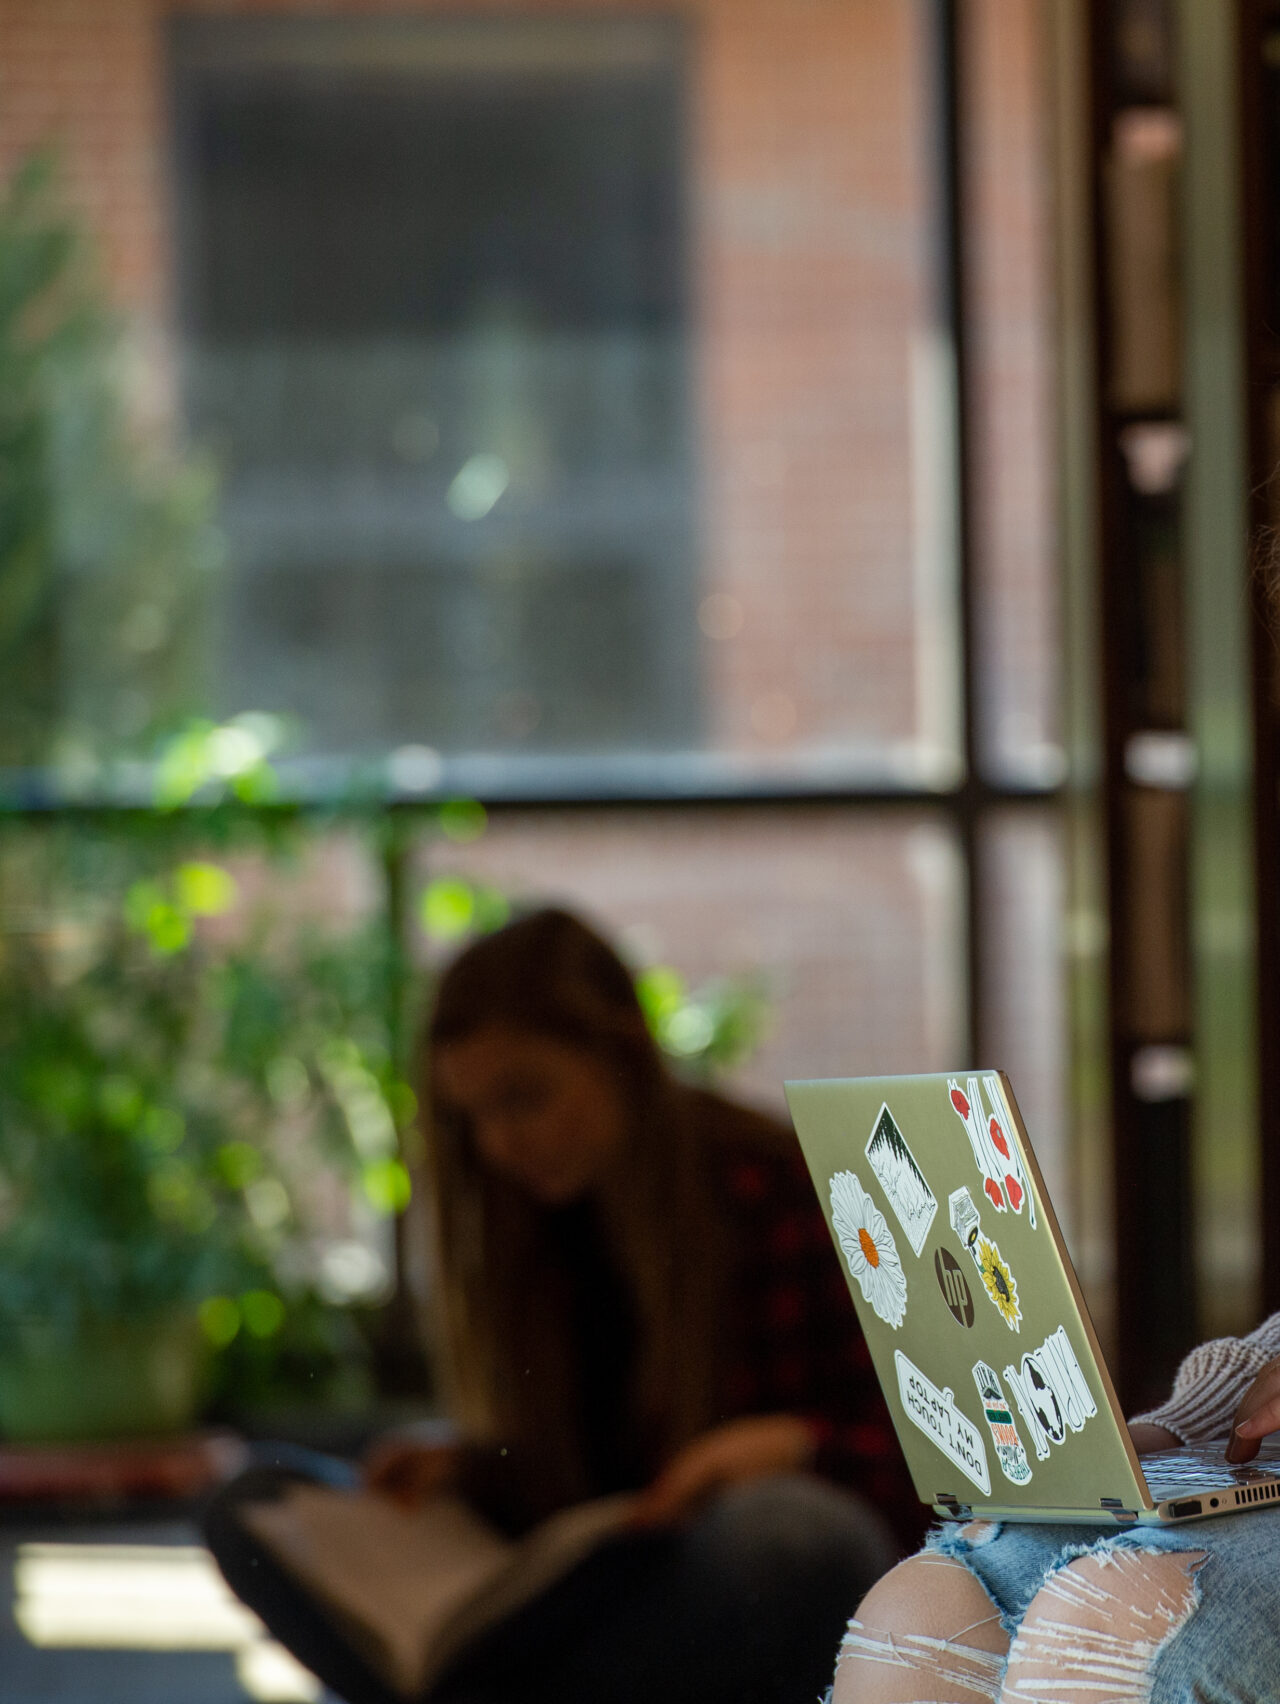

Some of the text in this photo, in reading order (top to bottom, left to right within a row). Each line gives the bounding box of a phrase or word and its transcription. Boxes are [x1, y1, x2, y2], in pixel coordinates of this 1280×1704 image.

[937, 1247, 969, 1328] hp
[906, 1390, 983, 1477] DON'T TOUCH
[908, 1376, 974, 1449] MY LAPTOP
[991, 1423, 1019, 1446] BOOKS
